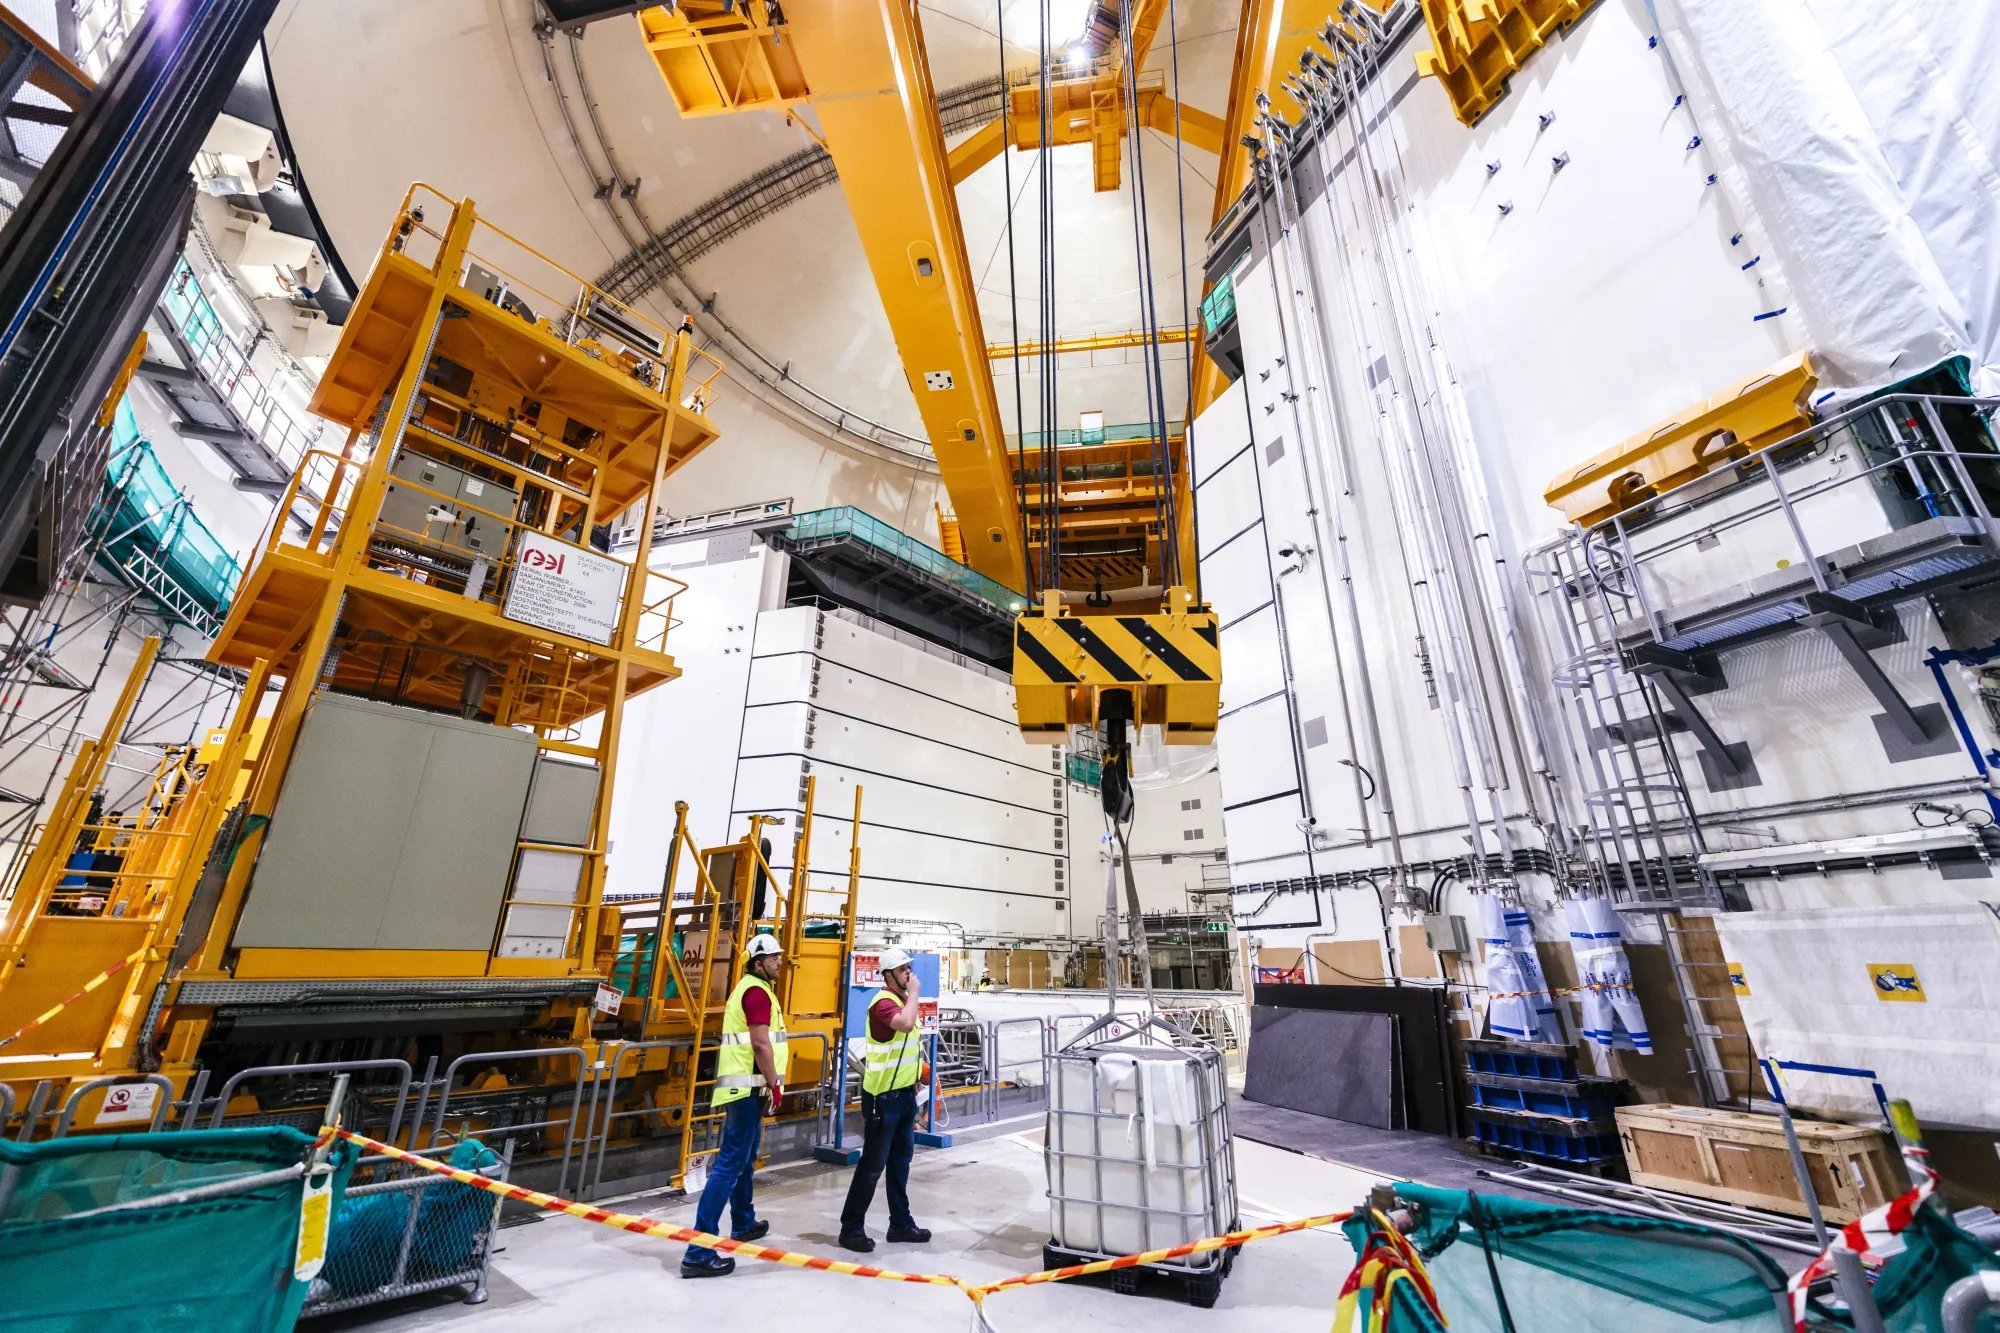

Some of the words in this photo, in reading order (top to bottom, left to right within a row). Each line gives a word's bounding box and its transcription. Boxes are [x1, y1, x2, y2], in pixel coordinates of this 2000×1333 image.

[518, 570, 565, 590] SARJANUMERO
[520, 564, 542, 576] SERIAL
[543, 572, 569, 585] NUMBER
[514, 588, 534, 598] RATED
[535, 595, 552, 604] LOAD
[517, 576, 535, 586] YEAR
[546, 585, 592, 604] CONSTRUCTION
[509, 606, 543, 620] OMAPAINO
[510, 600, 529, 610] DEAD
[530, 606, 554, 617] WEIGHT
[512, 594, 573, 617] NOSTOKAPASITEETTI
